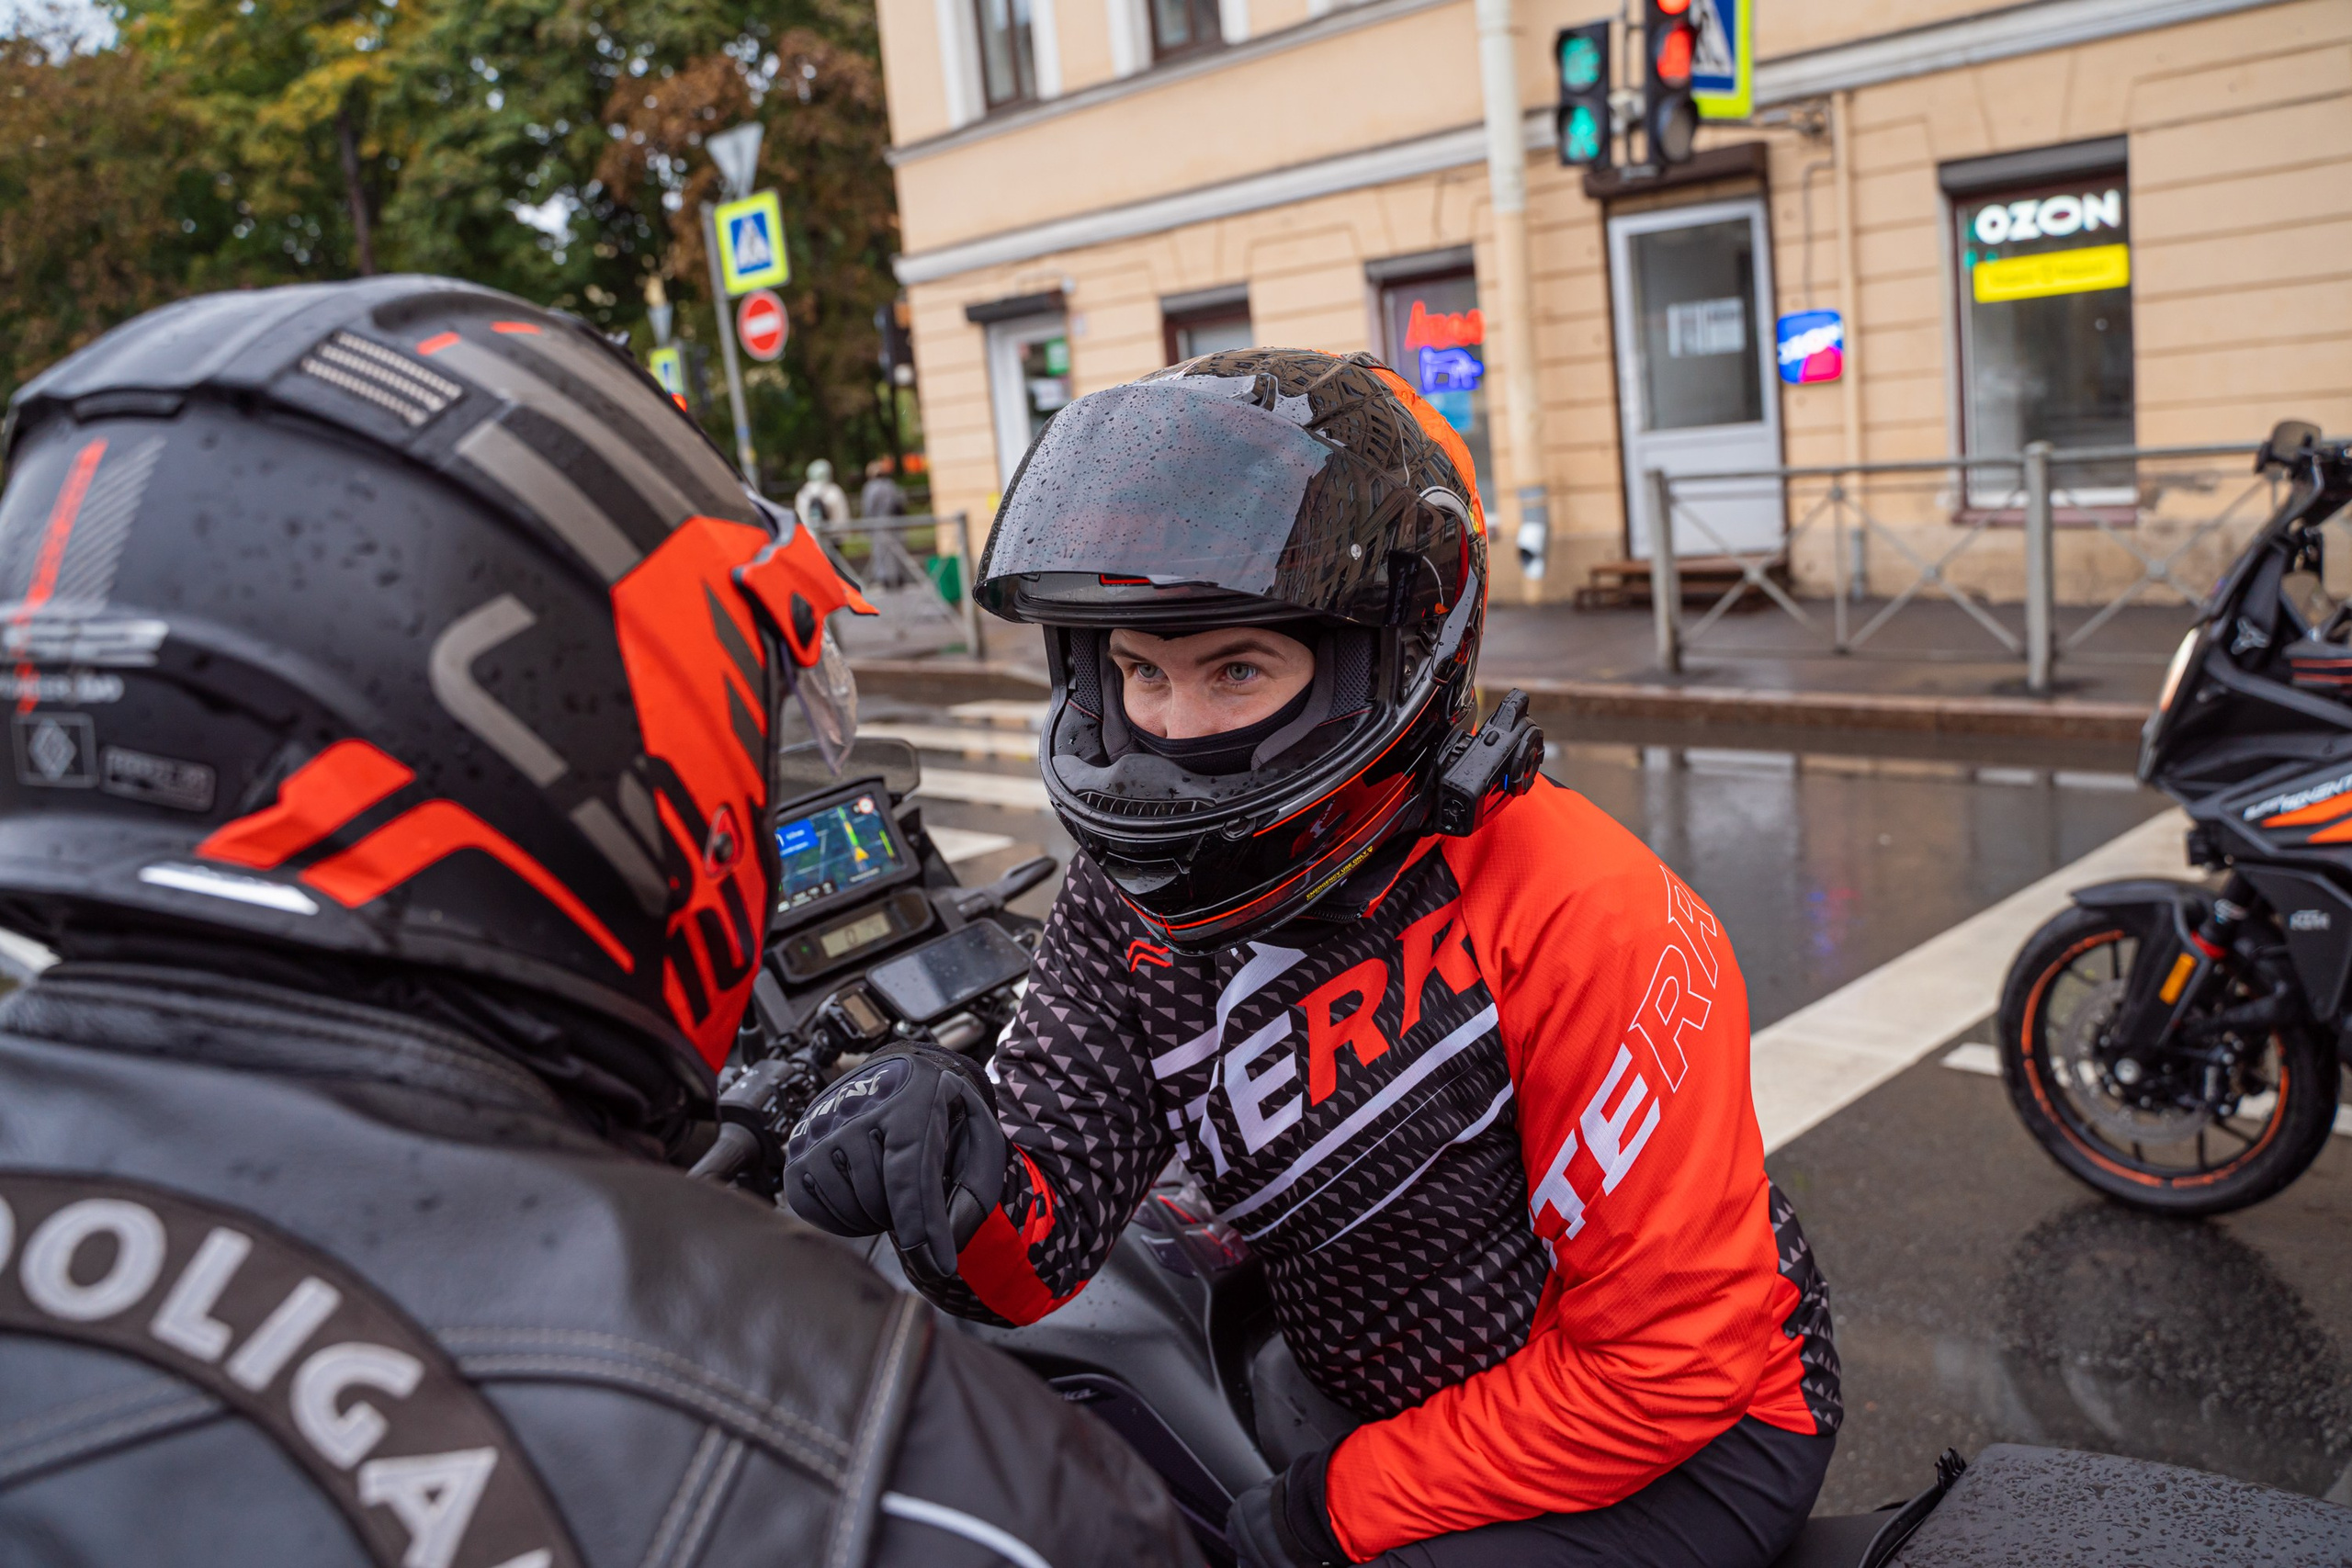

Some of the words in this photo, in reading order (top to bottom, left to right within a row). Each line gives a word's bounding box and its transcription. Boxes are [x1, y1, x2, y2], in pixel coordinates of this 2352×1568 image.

[1975, 189, 2120, 244] OZON
[1306, 872, 1340, 899] EMERGENCY
[1340, 862, 1352, 874] USE
[1352, 850, 1368, 865] ONLY
[0, 1197, 549, 1568] OLIGA
